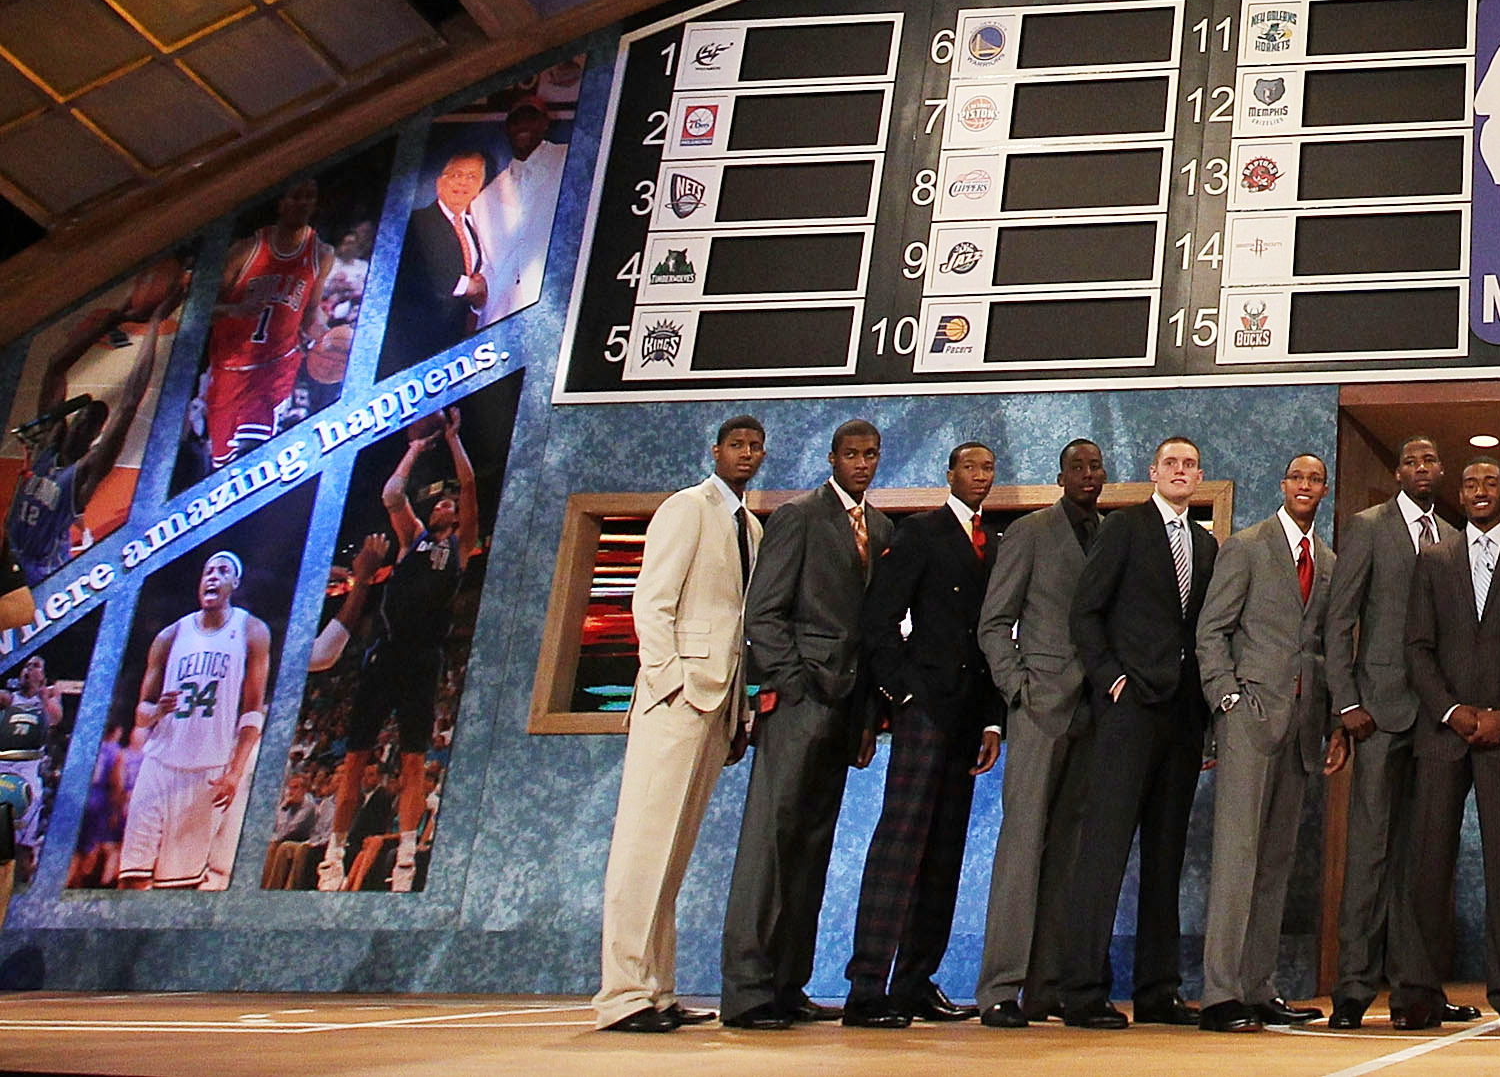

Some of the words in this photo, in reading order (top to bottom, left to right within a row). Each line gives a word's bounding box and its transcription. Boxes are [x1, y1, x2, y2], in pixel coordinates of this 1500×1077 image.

[930, 29, 955, 64] 6
[1192, 16, 1232, 53] 11
[660, 42, 677, 76] 1
[924, 99, 947, 134] 7
[1186, 86, 1235, 123] 12
[1248, 106, 1289, 118] MEMPHIS
[642, 111, 668, 145] 2
[676, 175, 704, 202] NETS
[912, 170, 937, 206] 8
[1180, 159, 1229, 197] 13
[631, 180, 656, 215] 3
[616, 251, 641, 288] 4
[903, 242, 928, 279] 9
[1175, 232, 1223, 271] 14
[250, 305, 274, 343] 1
[871, 315, 919, 355] 10
[1168, 308, 1219, 348] 15
[1236, 330, 1270, 346] BUCKS
[604, 325, 631, 362] 5
[644, 336, 680, 357] KINGS
[121, 438, 308, 569] amazing
[315, 339, 512, 456] happens.
[177, 651, 231, 681] CELTICS
[174, 680, 219, 719] 34
